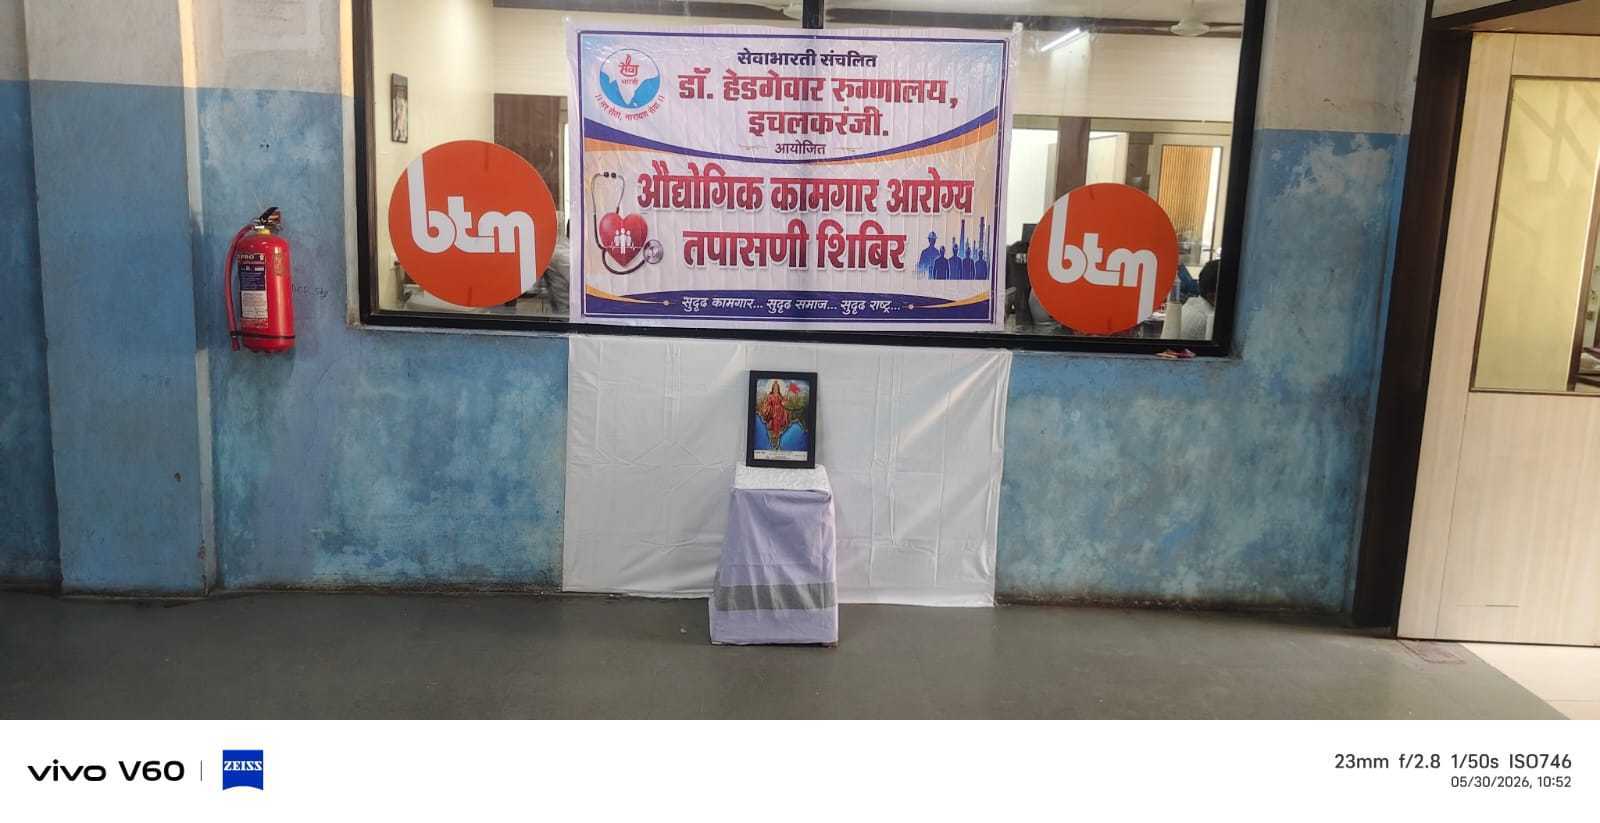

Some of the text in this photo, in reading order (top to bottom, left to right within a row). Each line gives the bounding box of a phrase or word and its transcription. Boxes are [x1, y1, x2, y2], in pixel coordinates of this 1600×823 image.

[737, 48, 878, 67] सेवाभारती संचलित
[678, 67, 959, 109] डॉ. हेडगेवार रुग्णालय,
[748, 106, 889, 136] इचलकरंजी.
[775, 139, 826, 155] आयोजित
[637, 160, 975, 213] औद्योगिक कामगार आरोग्य
[407, 154, 537, 294] btm
[682, 218, 907, 270] तपासणी शिबिर
[1047, 193, 1158, 325] btm
[711, 297, 764, 309] कामगार...
[795, 299, 837, 310] समाज...
